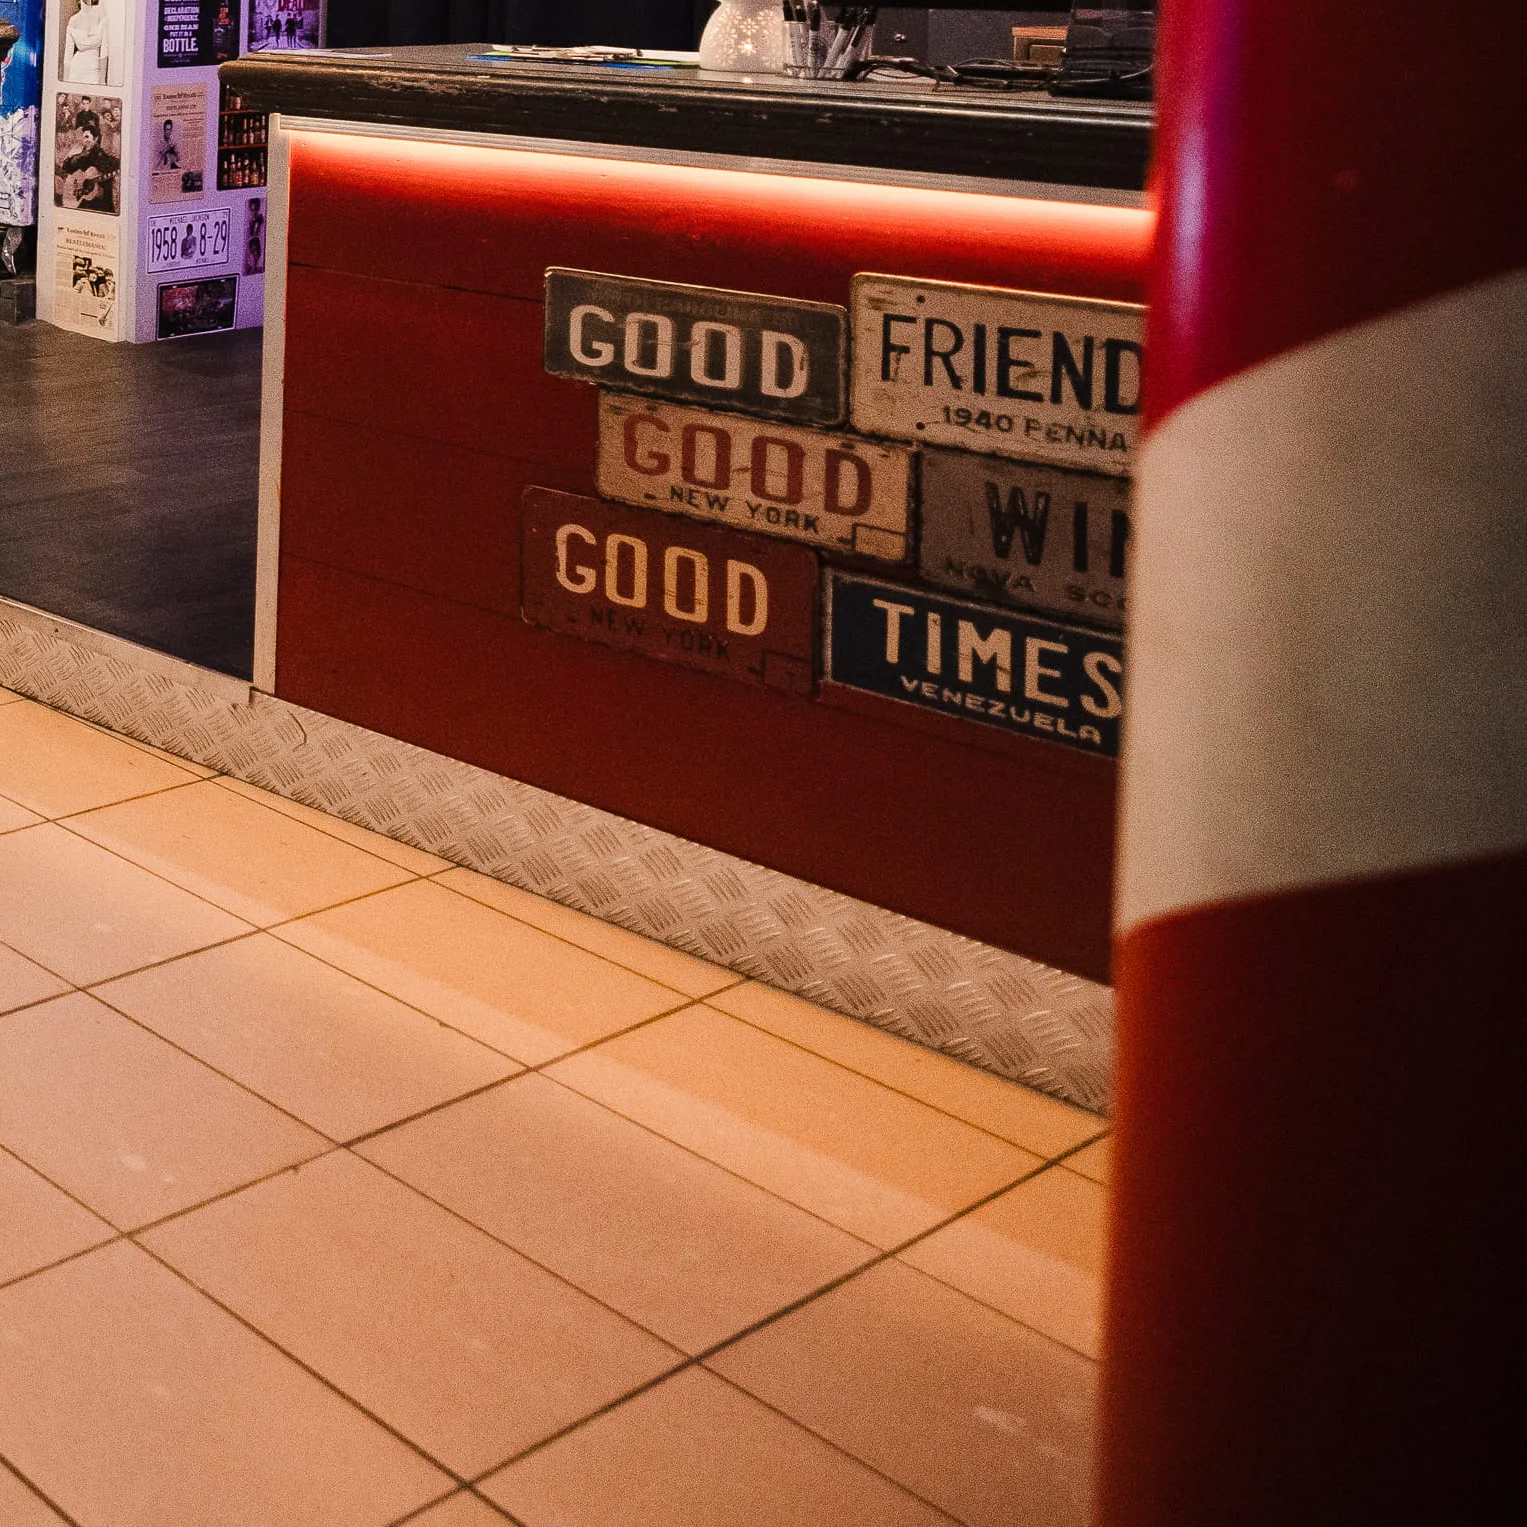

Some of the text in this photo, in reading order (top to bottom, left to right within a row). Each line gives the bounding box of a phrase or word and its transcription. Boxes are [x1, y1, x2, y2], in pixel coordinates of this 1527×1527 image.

[151, 220, 227, 263] 1958 8-29
[569, 304, 811, 399] GOOD
[881, 313, 1140, 417] FRIEND
[623, 413, 873, 518] GOOD
[942, 404, 1129, 454] 1940 PENNA
[669, 484, 822, 534] NEW YORK
[555, 523, 769, 637] GOOD
[590, 606, 732, 664] NEW YORK
[873, 598, 1124, 720] TIMES
[901, 674, 1102, 745] VENEZUELA
